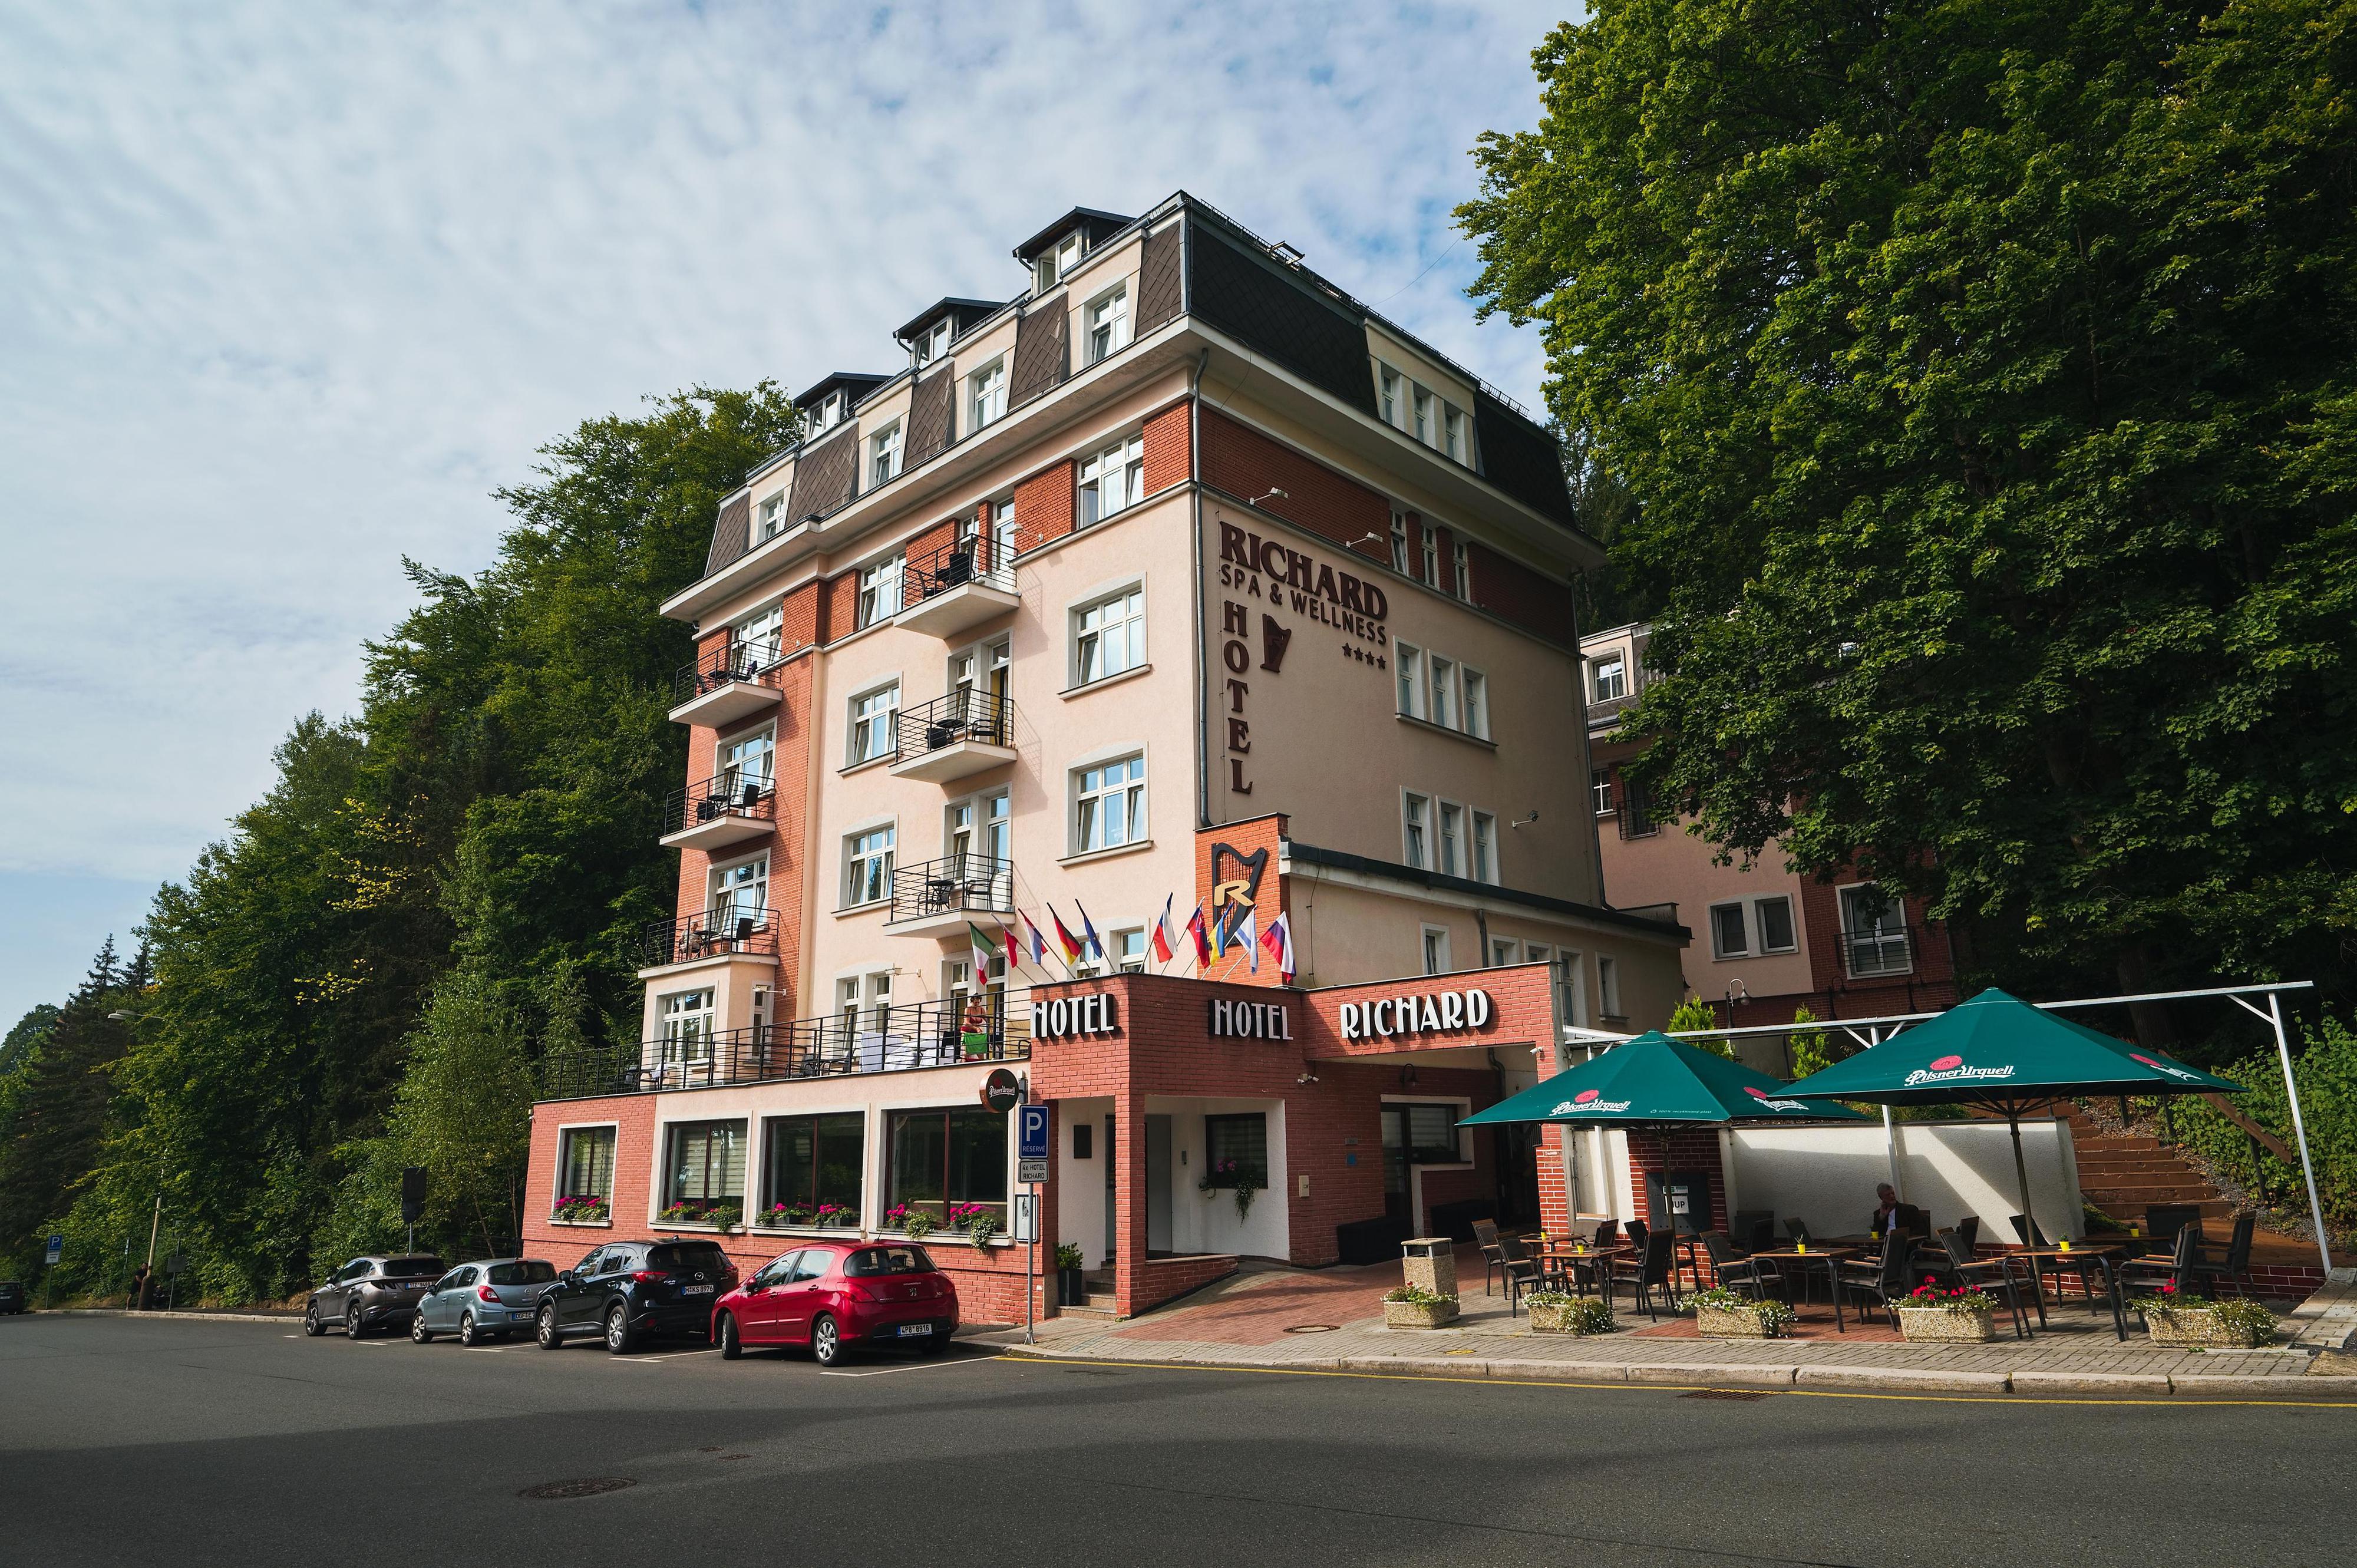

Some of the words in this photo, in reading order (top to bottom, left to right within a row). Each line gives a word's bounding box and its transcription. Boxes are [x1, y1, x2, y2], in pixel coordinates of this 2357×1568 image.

[1220, 521, 1388, 620] RICHARD
[1221, 564, 1261, 598] SPA
[1269, 583, 1282, 605] &
[1290, 590, 1387, 645] WELLNESS
[1223, 600, 1253, 794] HOTEL
[1031, 993, 1114, 1038] HOTEL
[1214, 999, 1293, 1040] HOTEL
[1340, 989, 1488, 1038] RICHARD
[1904, 1069, 1962, 1086] Pilsner
[1026, 1113, 1042, 1141] P
[1549, 1101, 1595, 1116] Pilsner
[916, 1324, 929, 1332] 8916
